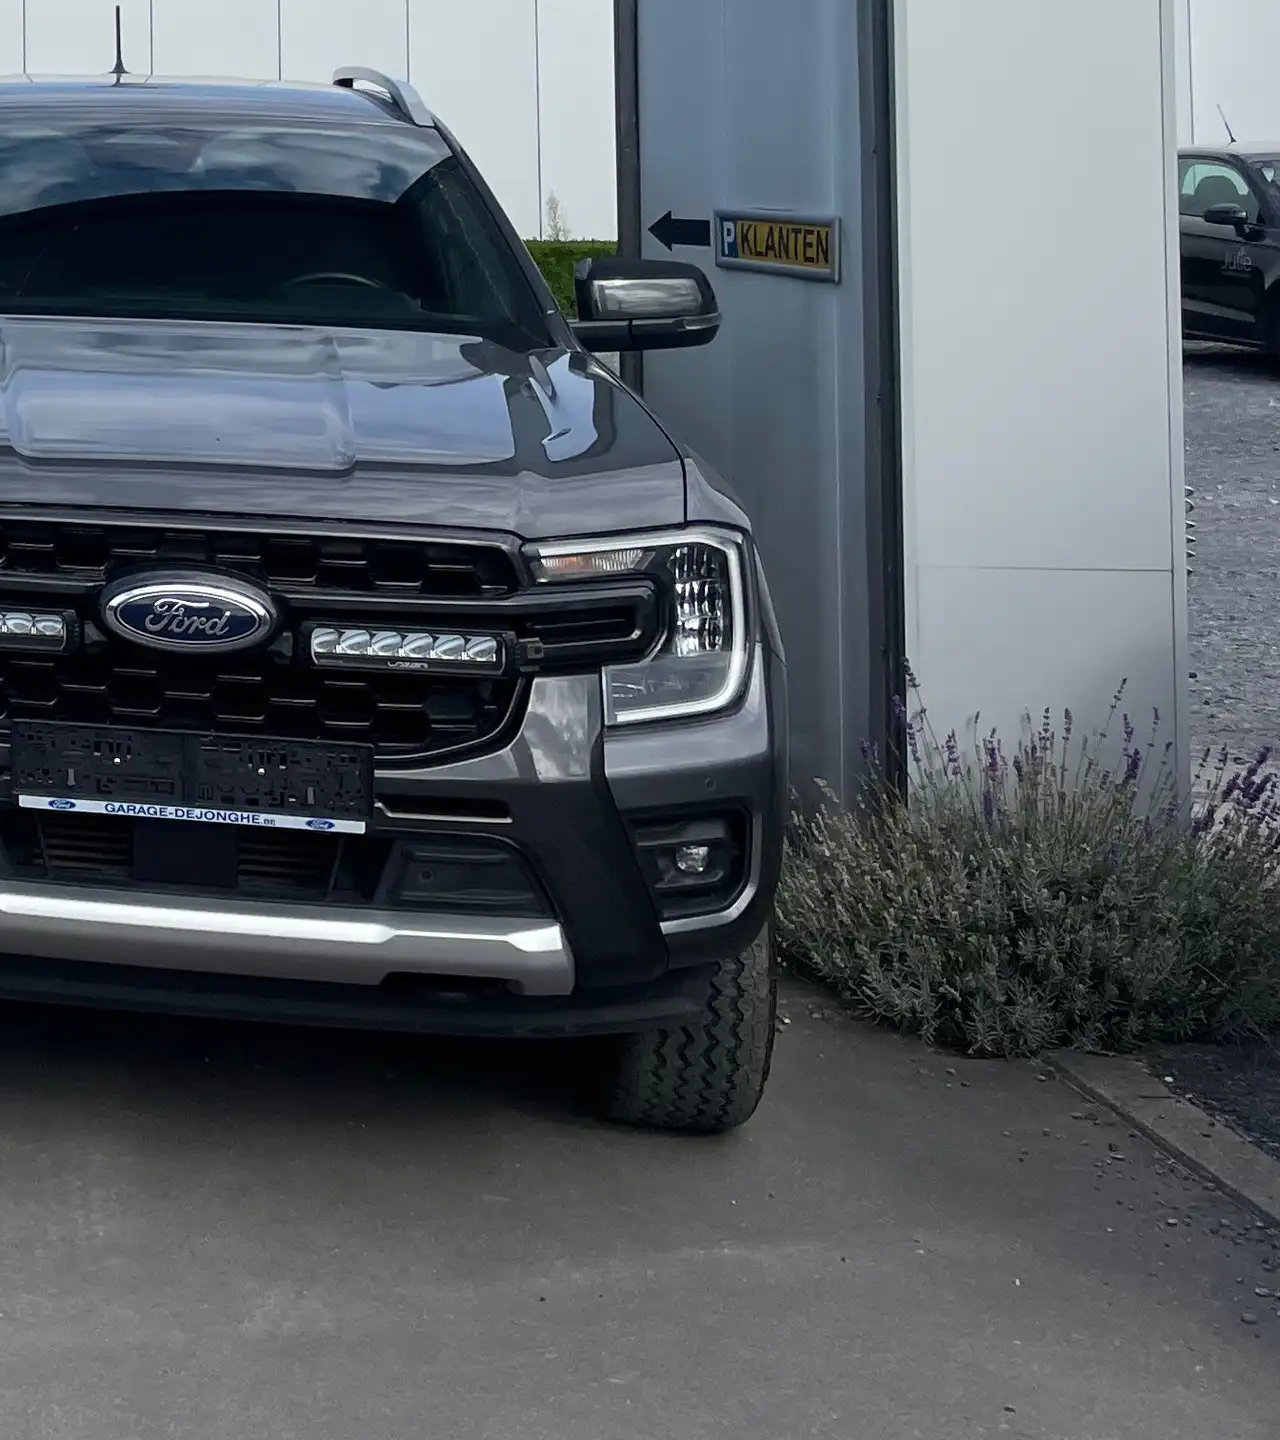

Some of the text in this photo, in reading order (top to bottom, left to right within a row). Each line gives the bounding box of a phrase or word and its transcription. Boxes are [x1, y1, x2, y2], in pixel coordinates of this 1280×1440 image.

[723, 221, 829, 264] P KLANTEN
[145, 598, 230, 636] Ford
